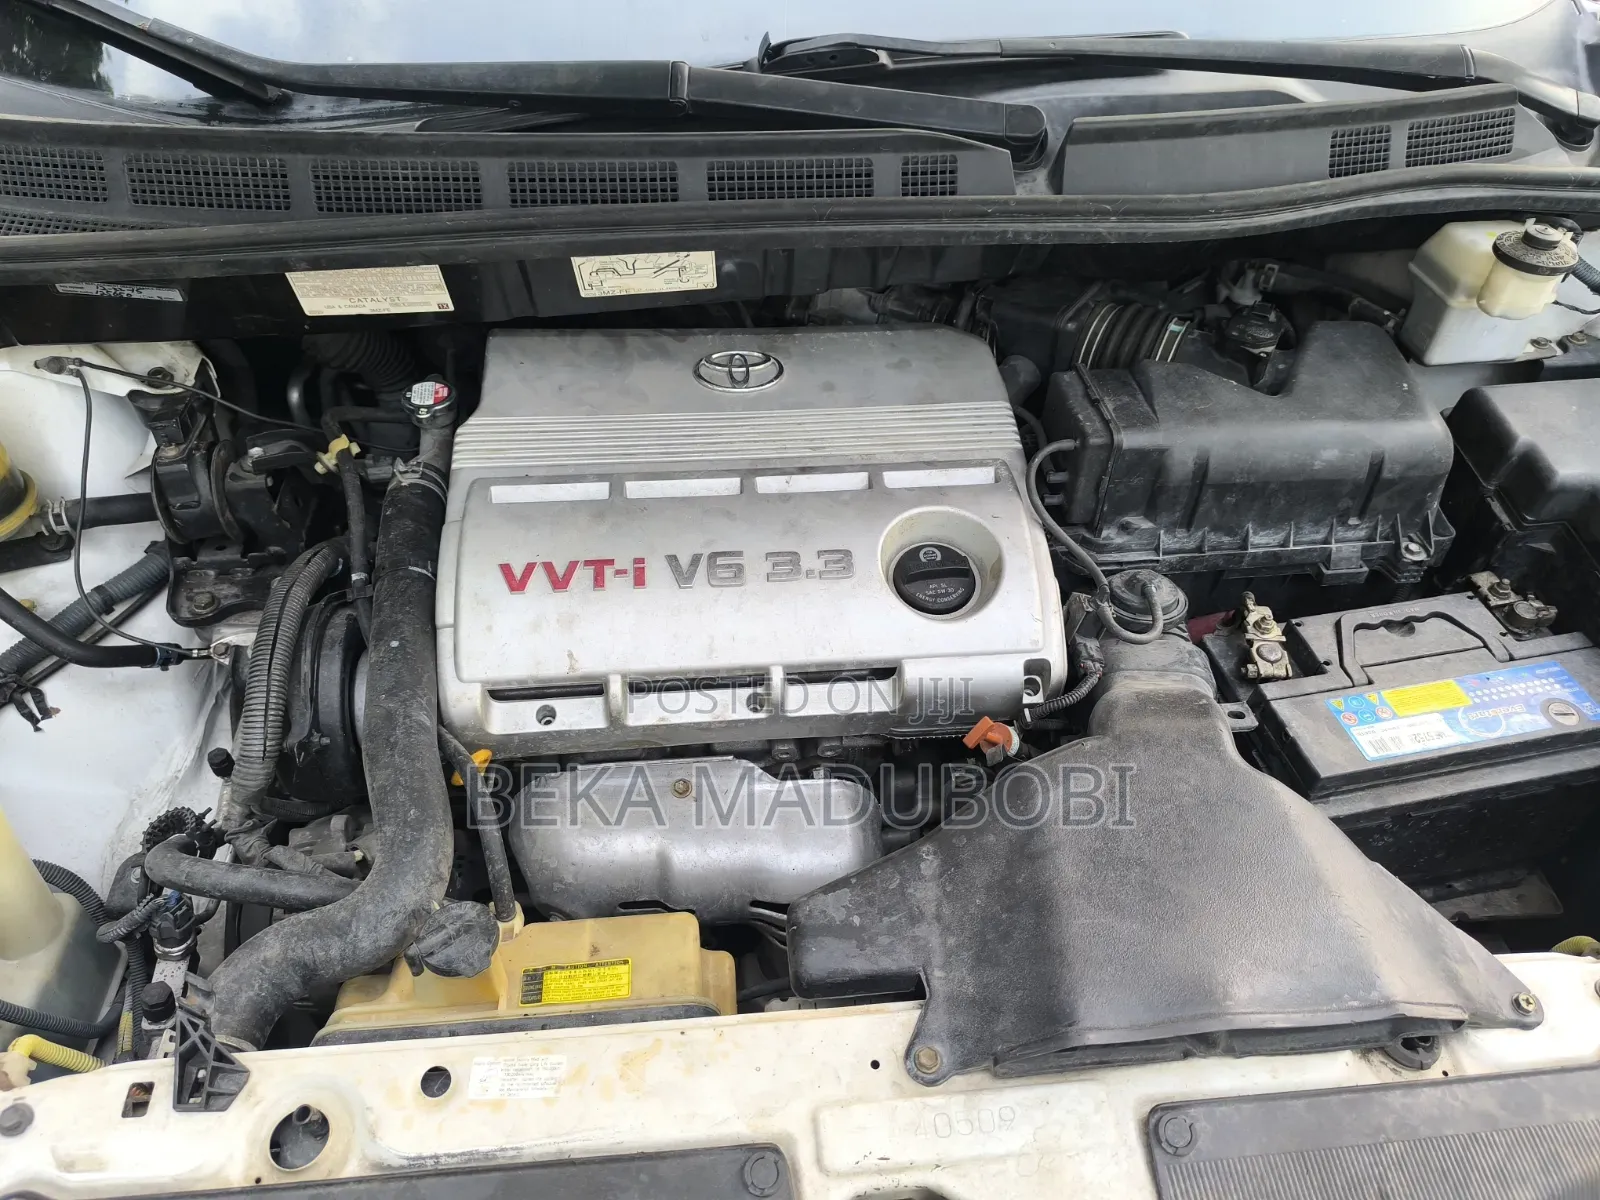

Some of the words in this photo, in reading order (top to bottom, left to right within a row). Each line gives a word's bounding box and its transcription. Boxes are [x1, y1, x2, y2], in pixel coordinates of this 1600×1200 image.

[348, 296, 401, 304] CATALYST
[498, 557, 647, 595] VVT-i
[664, 550, 747, 590] V6
[765, 549, 856, 583] 3.3
